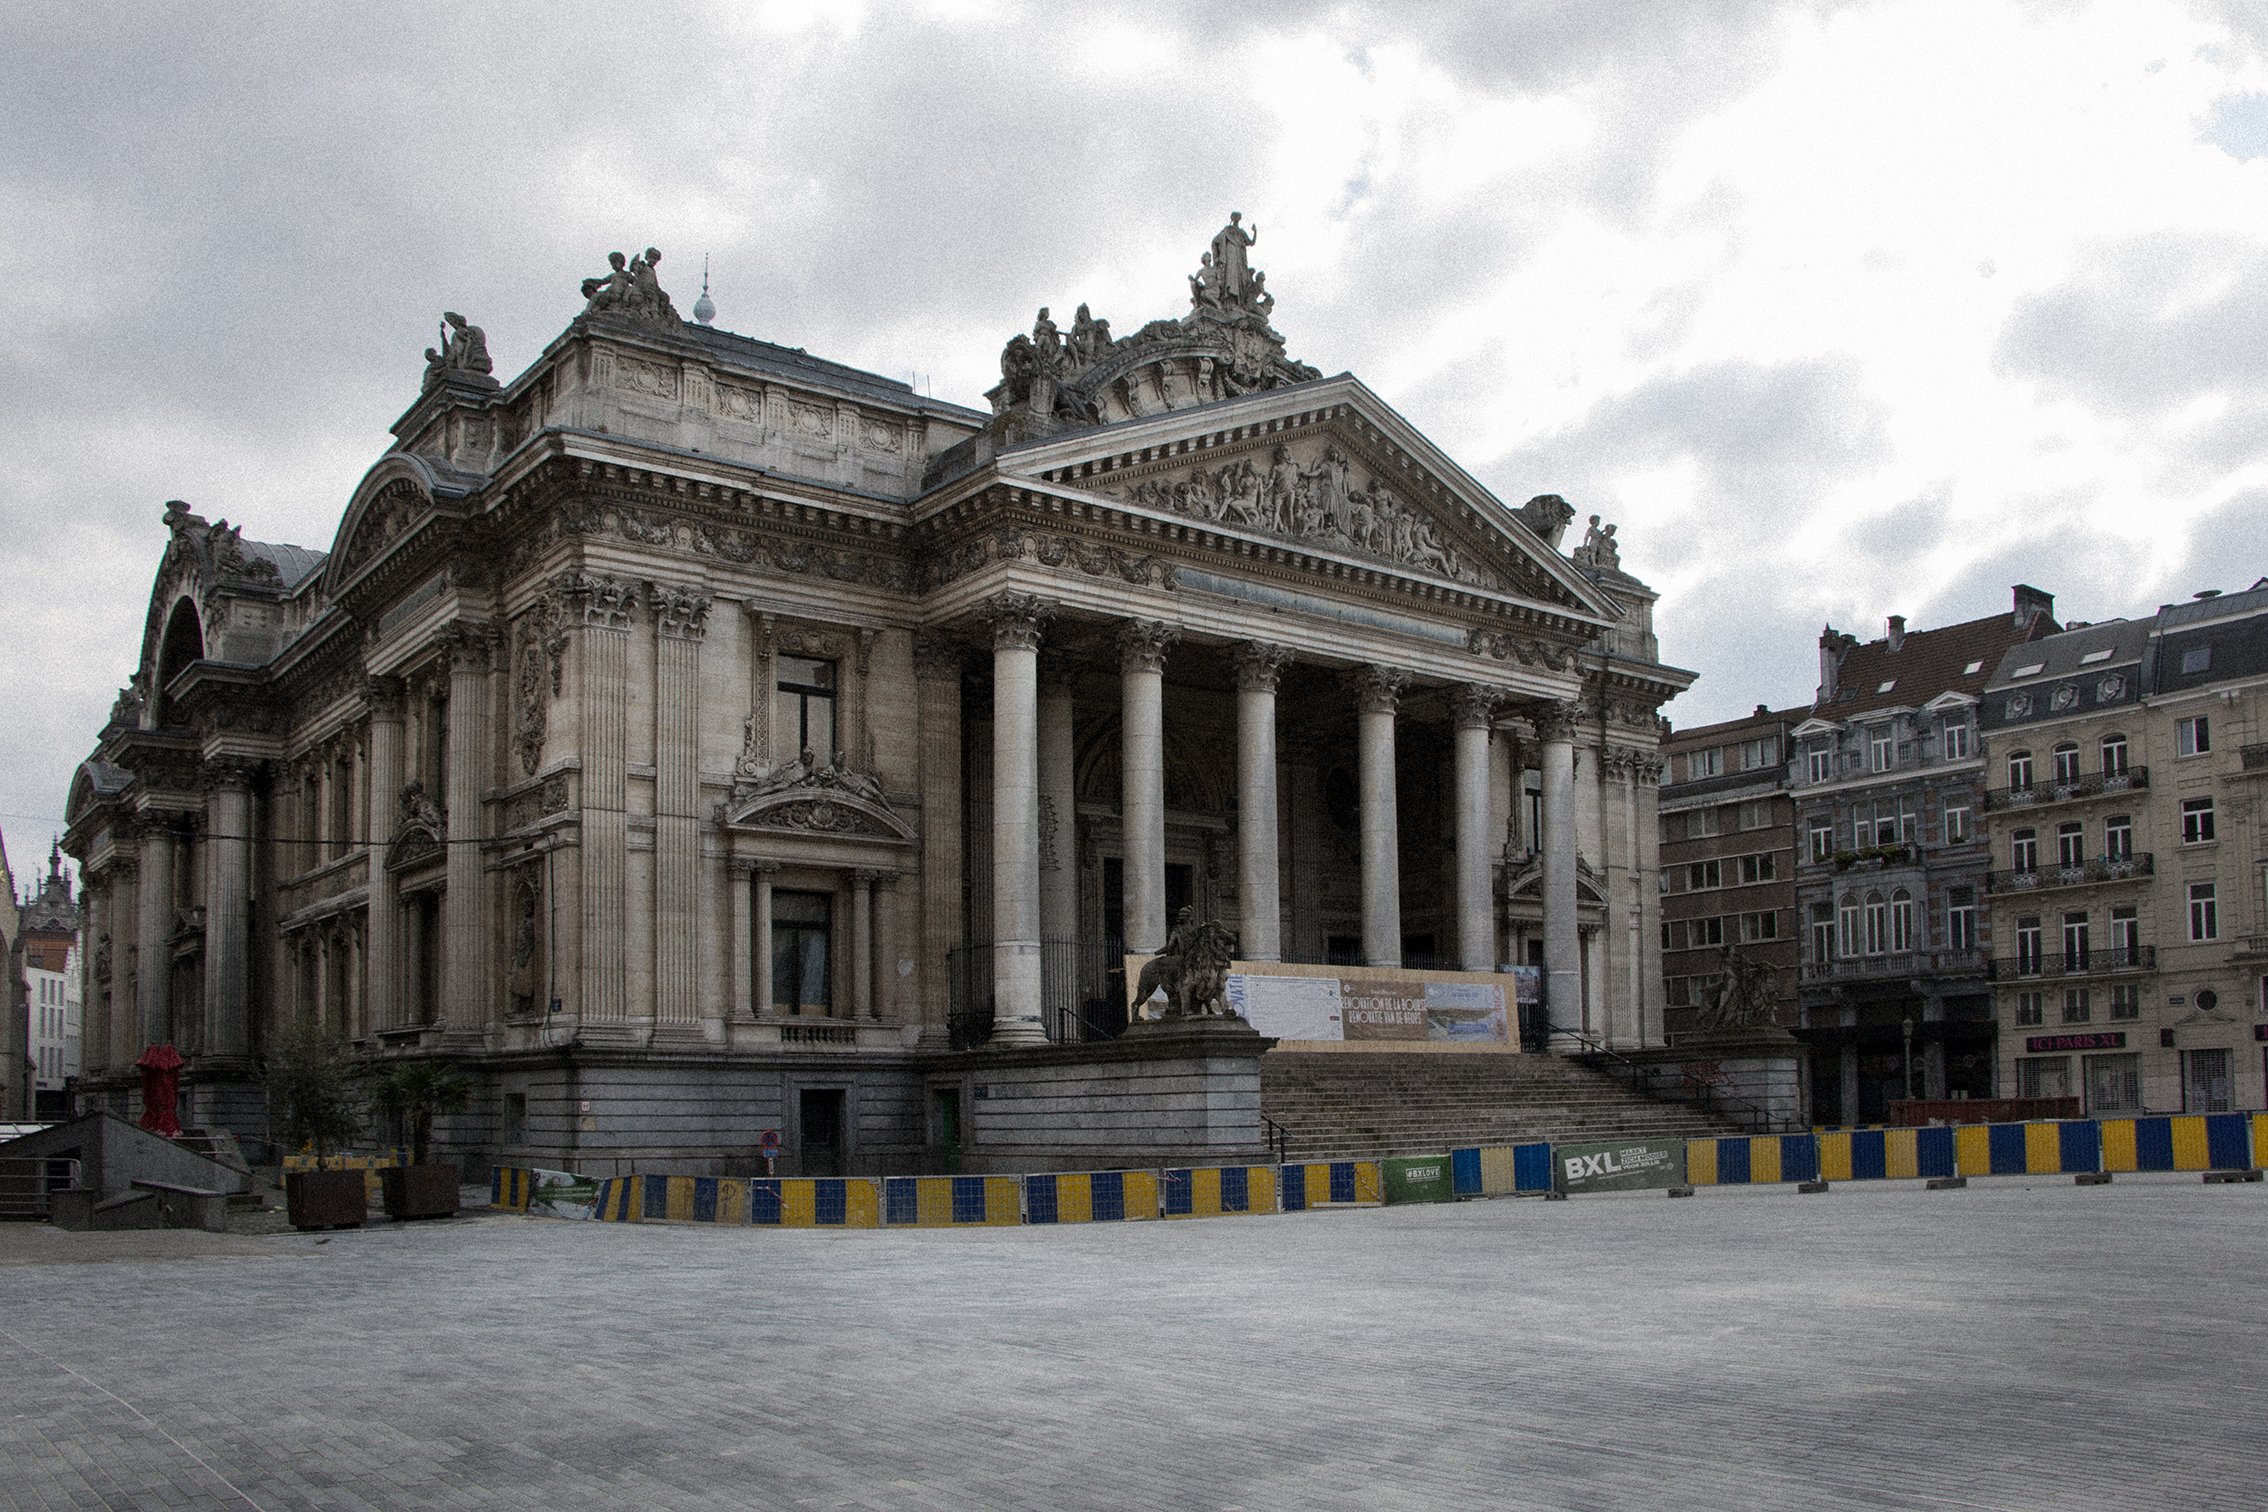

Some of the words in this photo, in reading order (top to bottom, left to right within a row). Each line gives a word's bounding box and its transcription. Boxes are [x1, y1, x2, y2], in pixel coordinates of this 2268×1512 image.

[1385, 998, 1393, 1011] DE
[1393, 998, 1401, 1011] LA
[1401, 998, 1427, 1012] BOURSE
[1349, 1010, 1383, 1024] RENOVATIE
[1384, 1011, 1395, 1024] VAN
[1396, 1011, 1404, 1024] DE
[1404, 1011, 1422, 1025] BEURS
[2033, 1038, 2053, 1051] ICI
[2056, 1035, 2096, 1049] PARIS
[2100, 1034, 2119, 1048] XL
[1621, 1147, 1645, 1156] MAAKT
[1640, 1152, 1667, 1161] MOOIER
[1564, 1152, 1622, 1180] BXL
[1640, 1160, 1660, 1168] JULLIE
